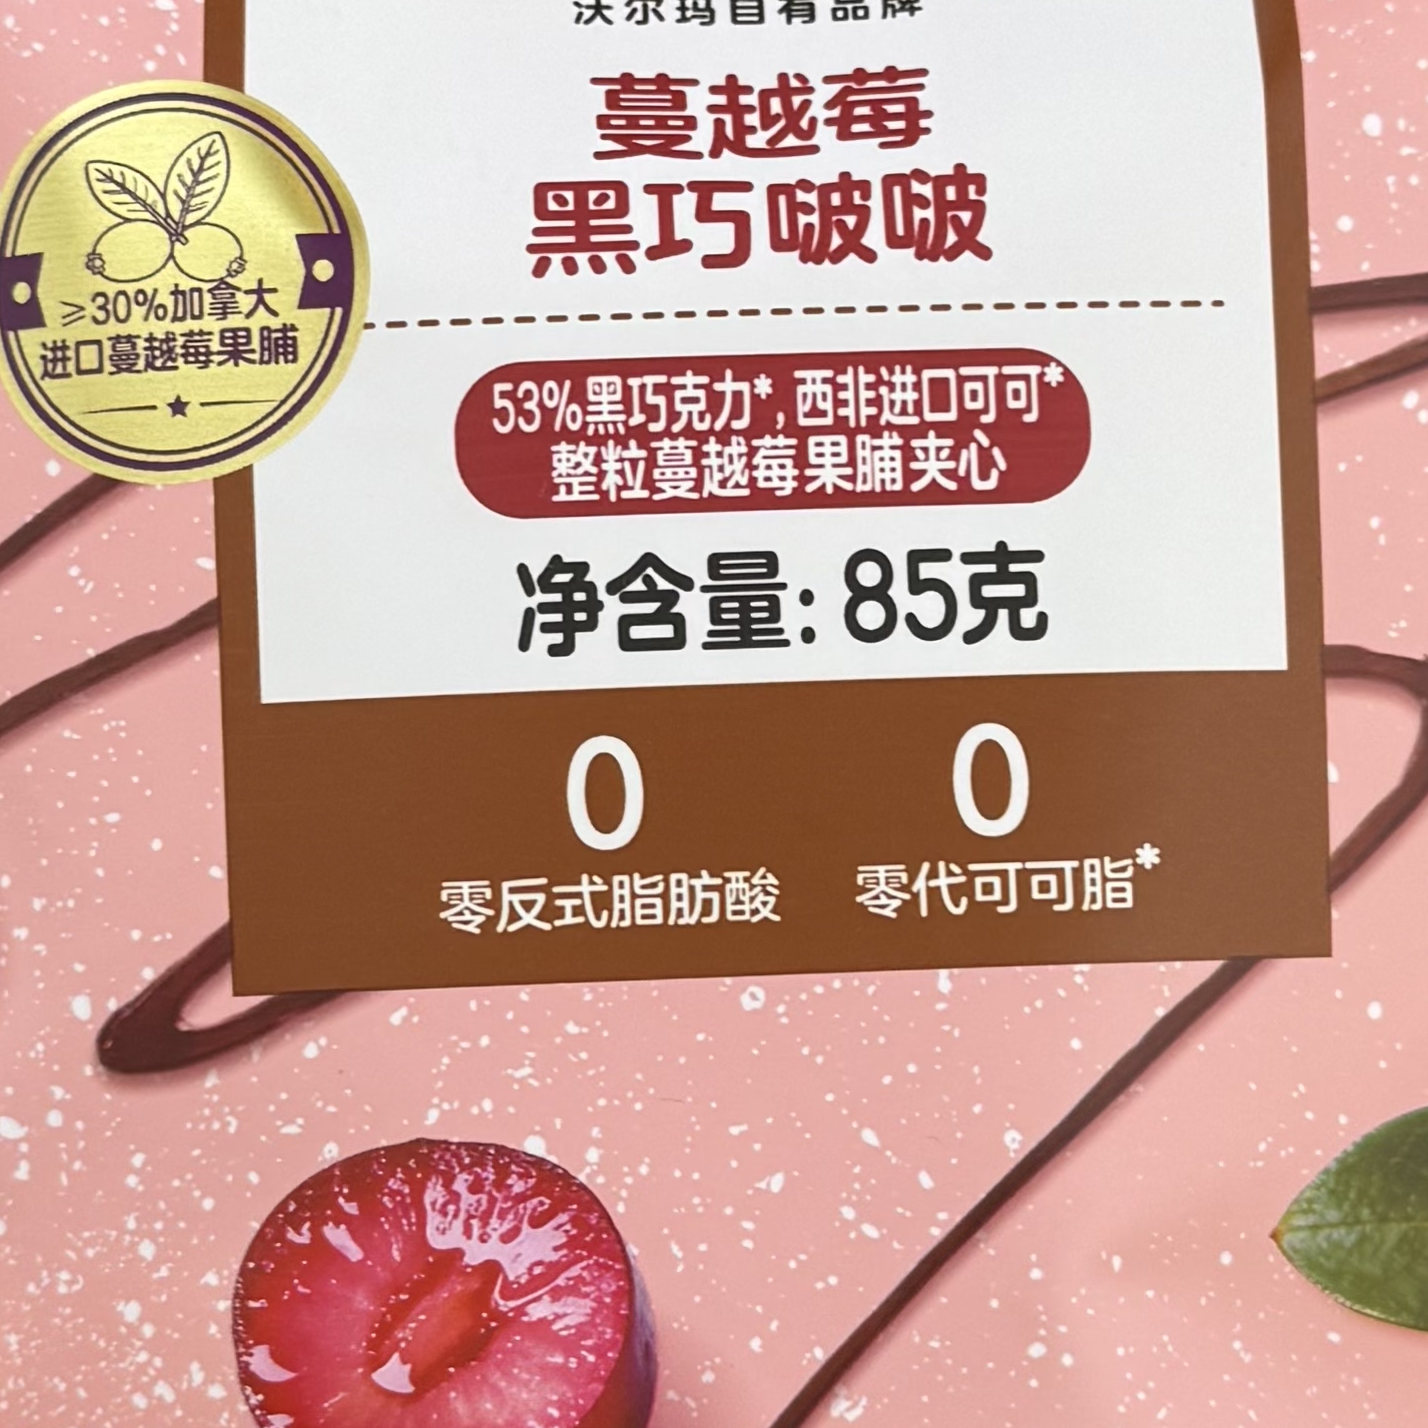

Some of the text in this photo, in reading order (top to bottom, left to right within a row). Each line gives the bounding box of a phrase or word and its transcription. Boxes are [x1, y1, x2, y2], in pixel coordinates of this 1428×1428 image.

[589, 65, 934, 161] 蔓越莓
[525, 163, 993, 278] 黑巧啵啵
[60, 278, 280, 327] ≥30%加拿大
[40, 323, 300, 380] 进口蔓越莓果脯
[549, 430, 1007, 504] 整粒蔓越莓果脯夹心
[566, 735, 645, 852] 0
[952, 722, 1030, 838] 0
[439, 867, 782, 934] 零反式脂肪酸
